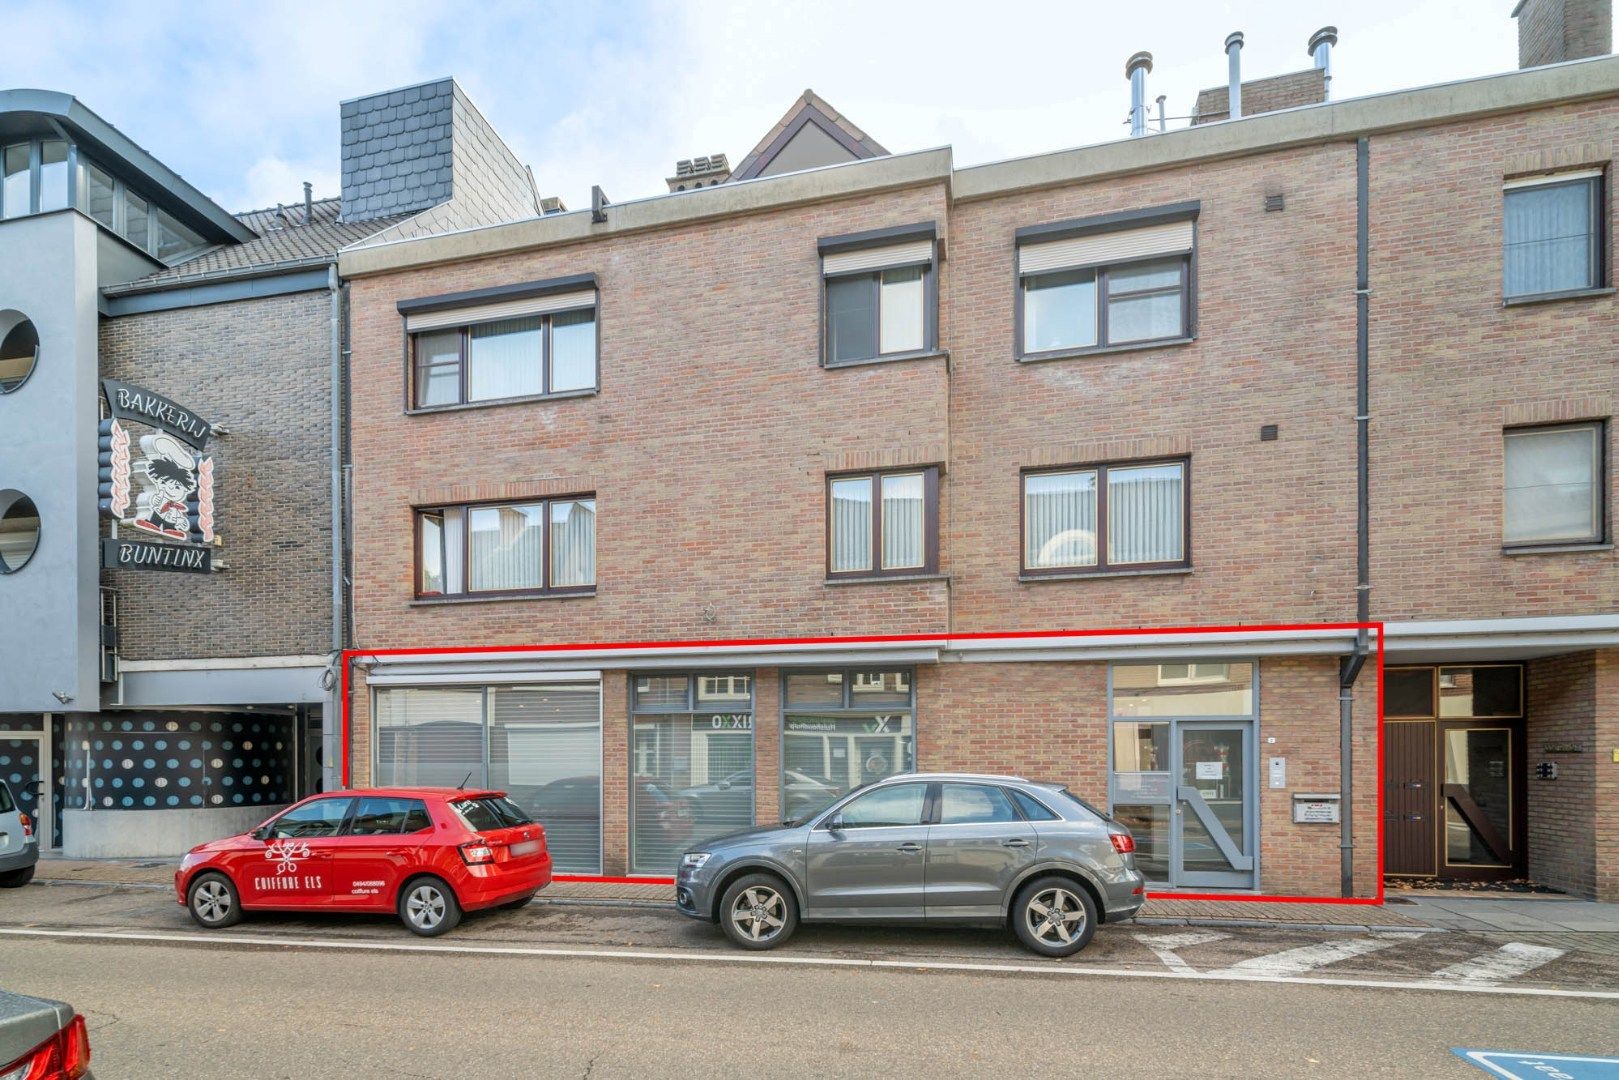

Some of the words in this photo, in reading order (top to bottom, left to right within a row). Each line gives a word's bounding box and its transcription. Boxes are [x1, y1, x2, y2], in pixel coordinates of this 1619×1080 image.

[117, 388, 206, 438] BAKKERIJ
[119, 543, 205, 568] BUNTINX
[305, 875, 322, 889] ELS
